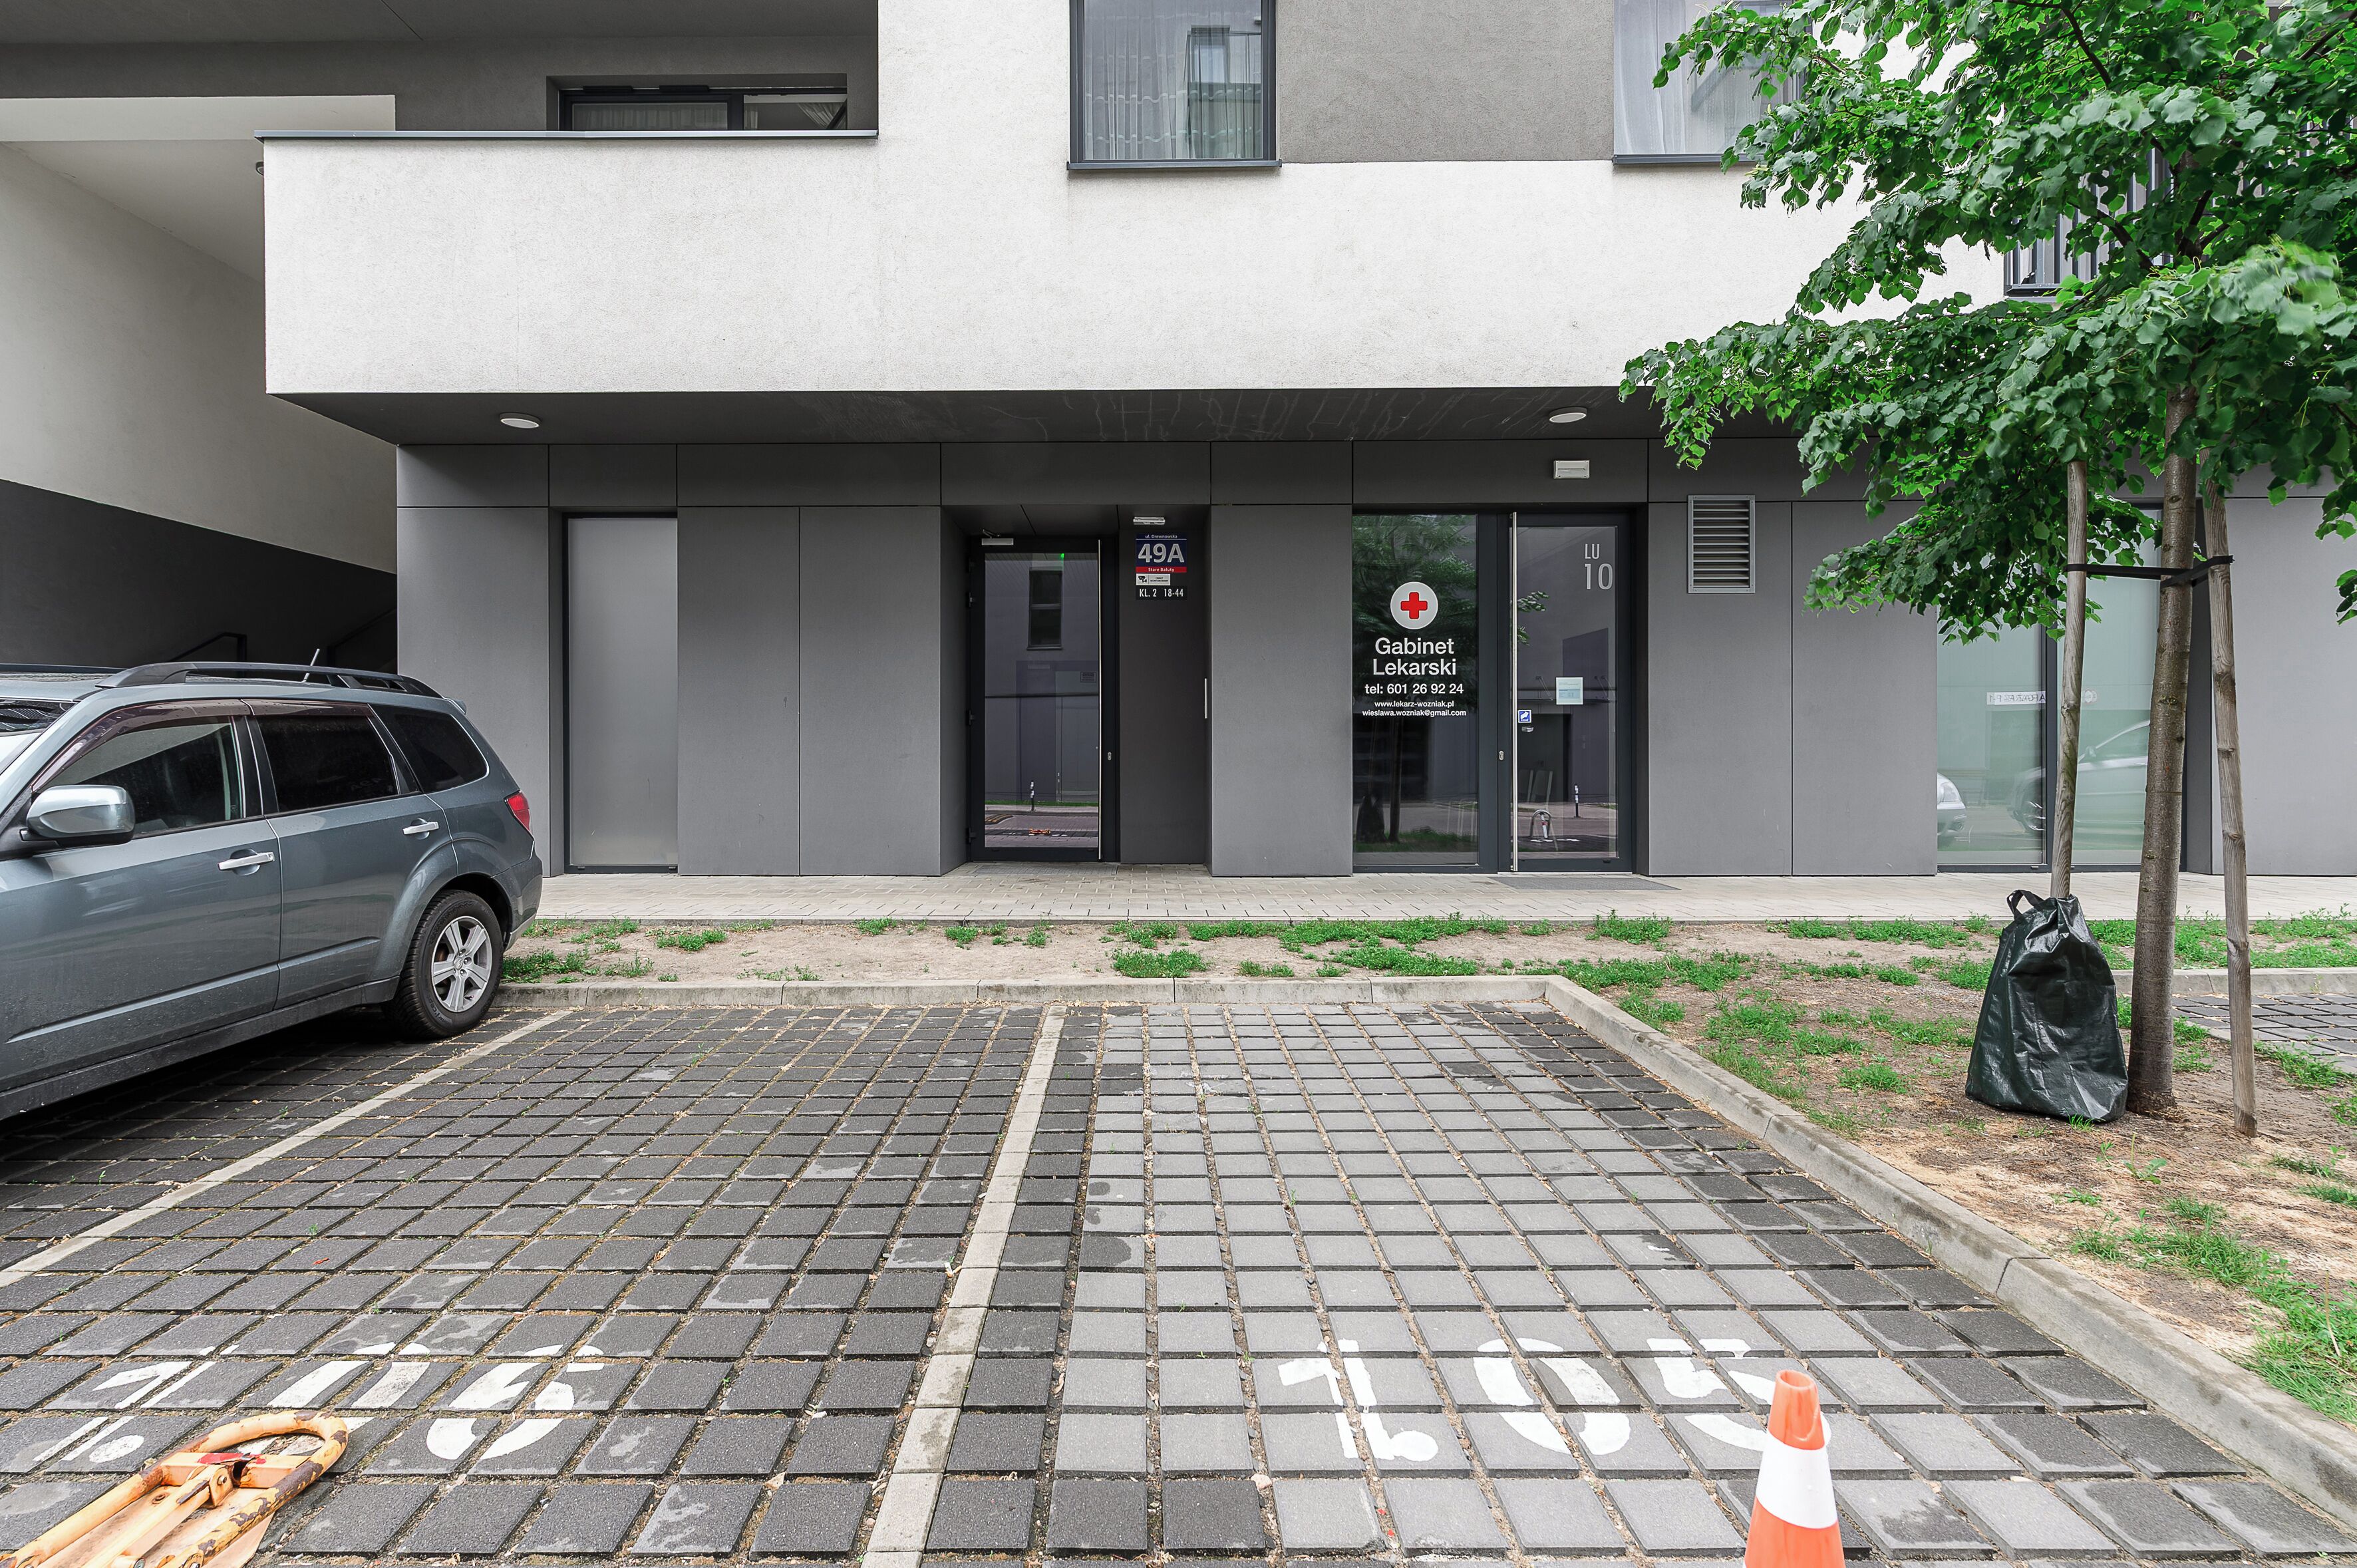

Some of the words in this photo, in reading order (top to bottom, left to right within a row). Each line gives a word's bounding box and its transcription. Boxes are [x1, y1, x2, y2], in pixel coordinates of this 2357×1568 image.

[1138, 543, 1185, 563] 49A
[1585, 544, 1600, 559] LU
[1585, 563, 1613, 589] 10
[1139, 588, 1150, 597] KL.
[1152, 588, 1157, 597] 2
[1164, 588, 1183, 597] 18-44
[1375, 637, 1454, 655] Gabinet
[1373, 659, 1456, 675] Lekarski
[1364, 683, 1383, 694] tel:
[1386, 683, 1407, 694] 601
[1412, 683, 1428, 694] 26
[1430, 683, 1446, 694] 92
[1449, 683, 1464, 694] 24
[1362, 709, 1467, 718] wieslawa.wozniak@gmail.com
